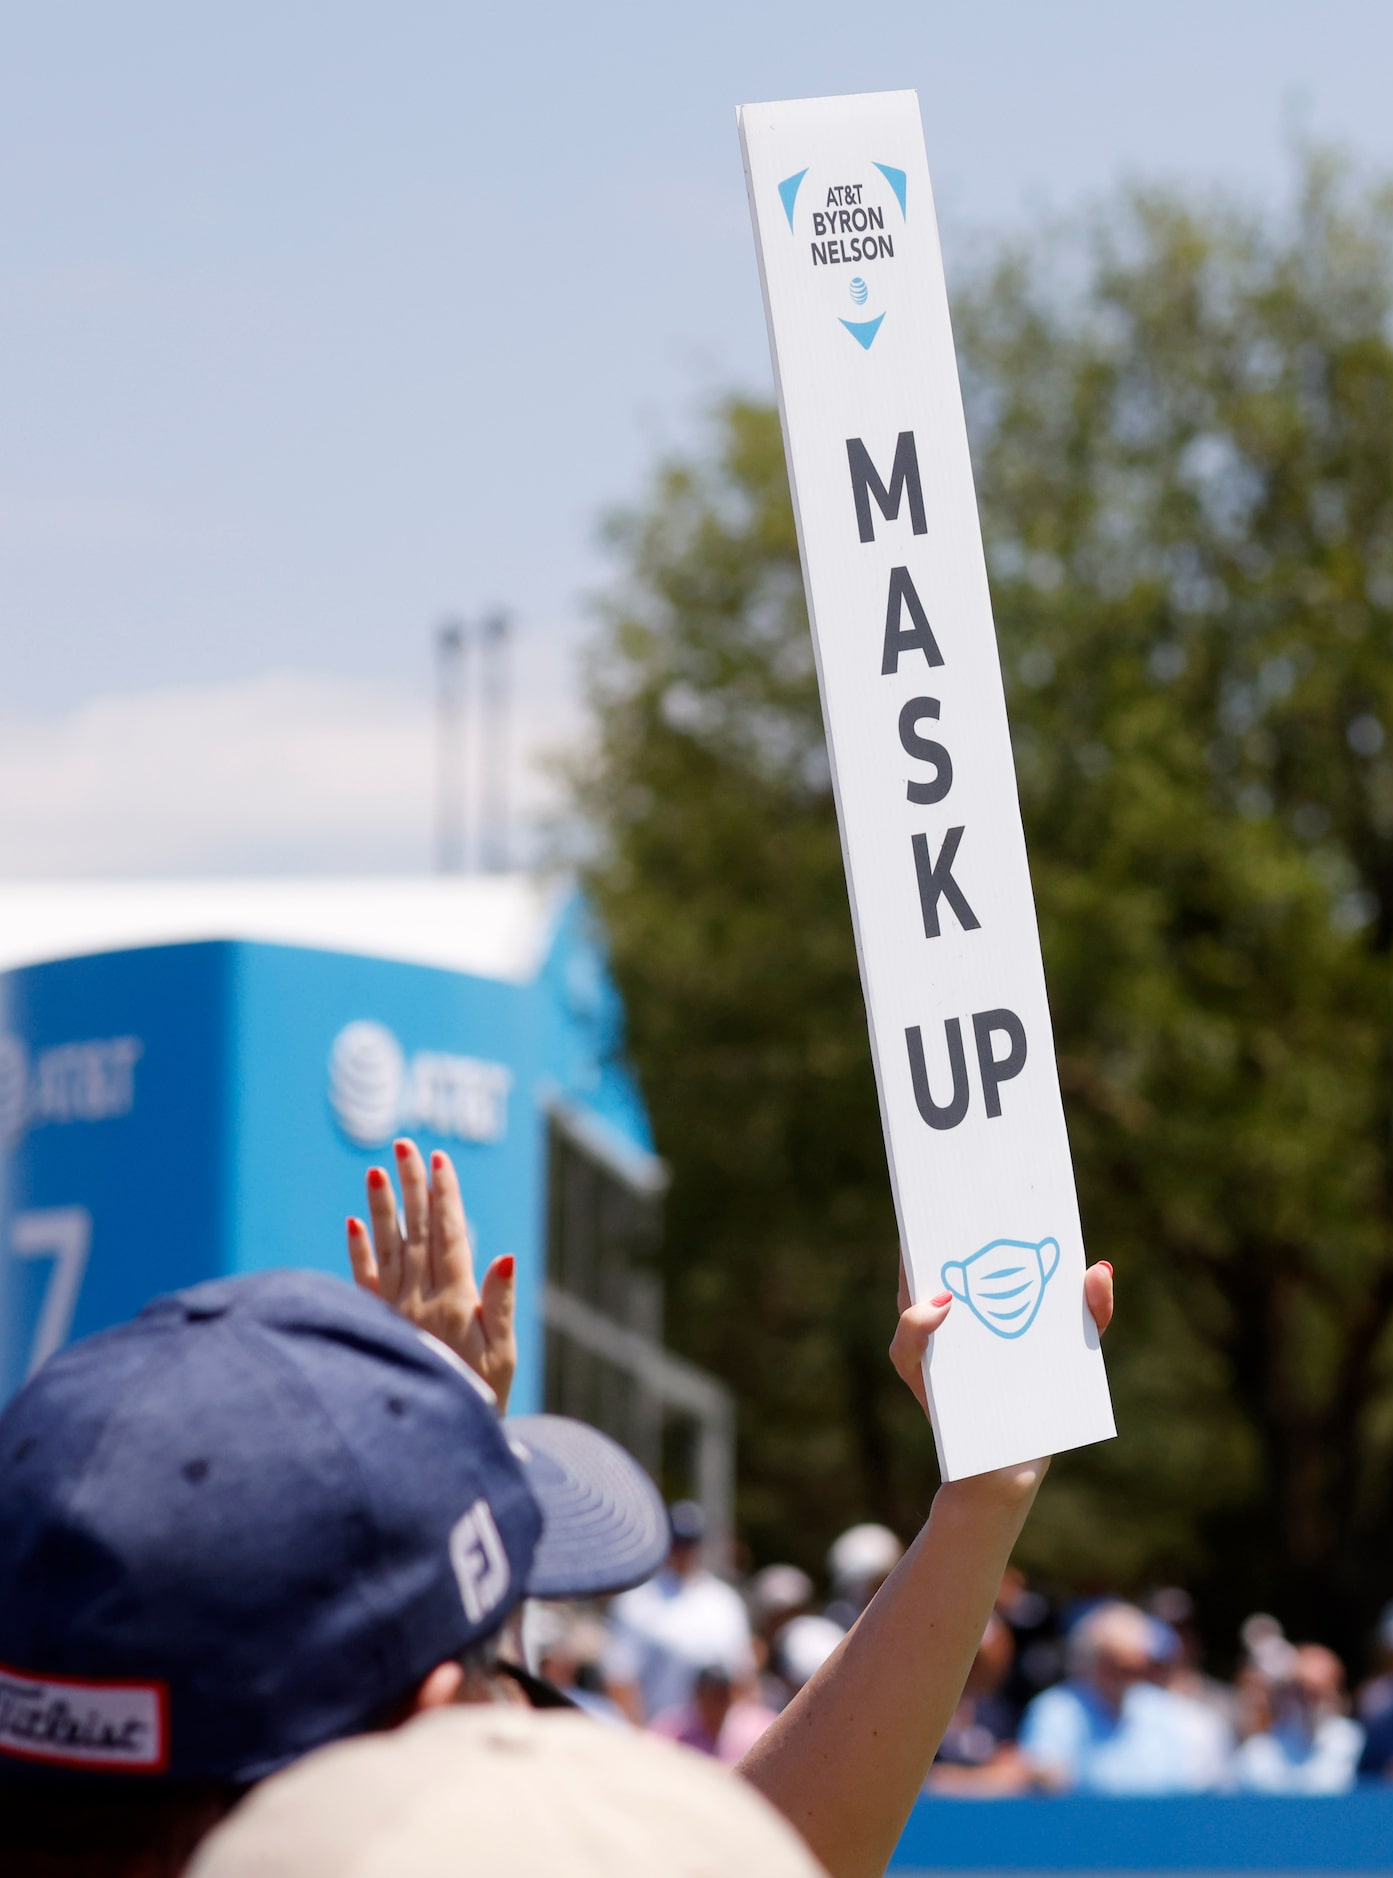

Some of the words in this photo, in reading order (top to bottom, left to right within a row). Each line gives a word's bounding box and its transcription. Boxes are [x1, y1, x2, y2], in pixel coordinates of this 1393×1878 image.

[826, 183, 863, 207] AT&T
[813, 207, 885, 235] BYRON
[811, 235, 894, 265] NELSON
[845, 430, 982, 939] MASK
[904, 1008, 1028, 1131] UP
